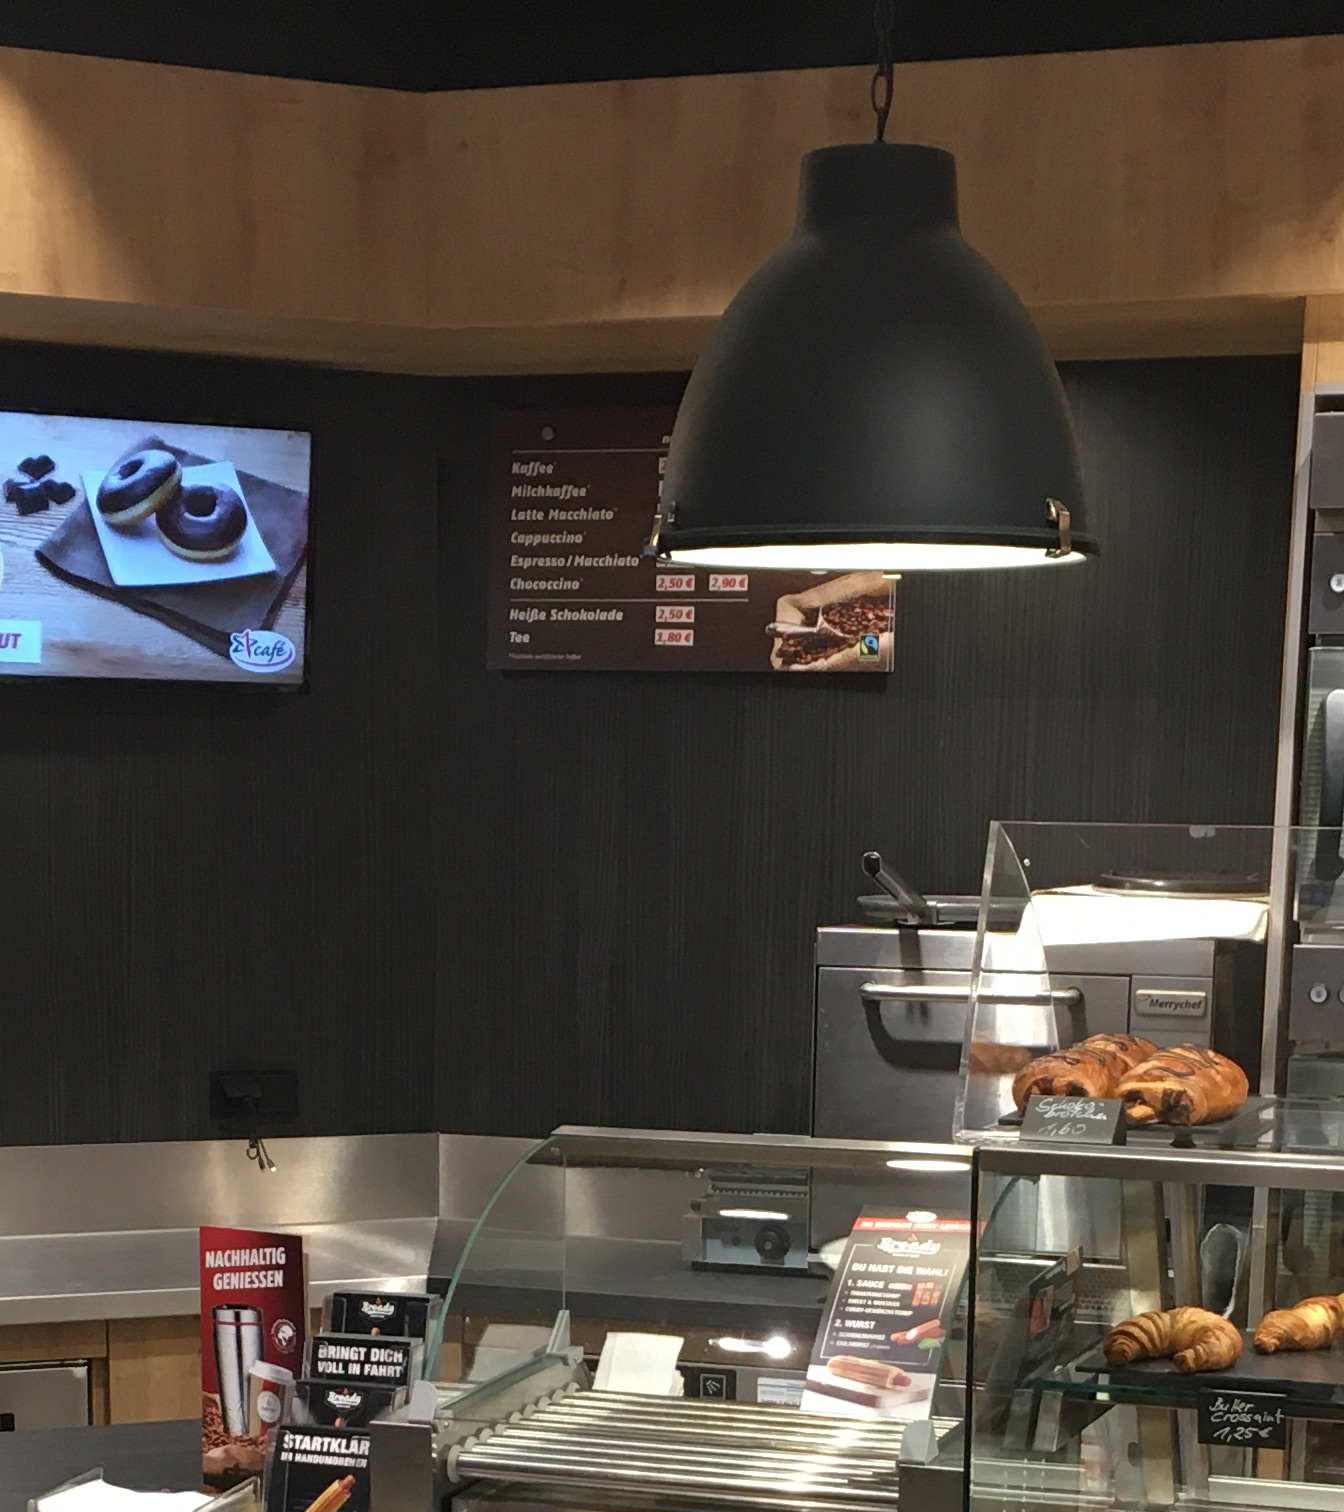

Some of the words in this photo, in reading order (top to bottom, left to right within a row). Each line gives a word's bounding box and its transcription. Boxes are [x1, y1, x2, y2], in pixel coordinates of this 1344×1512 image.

[511, 461, 554, 476] Kaffee
[511, 484, 587, 500] Milchkaffee
[511, 508, 544, 521] Latte
[548, 507, 614, 521] Macchiato
[510, 530, 583, 547] Cappuccino
[510, 577, 580, 591] Chococcino
[657, 578, 683, 591] 2,50
[710, 577, 737, 591] 2,90
[509, 608, 546, 623] Heiße
[550, 608, 624, 622] Schokolade
[657, 608, 683, 622] 2,50
[509, 631, 530, 643] Tee
[656, 632, 682, 645] 1,80
[254, 637, 288, 661] café
[1148, 998, 1202, 1011] Merrychef
[205, 1247, 286, 1269] NACHHALTIG
[852, 1262, 866, 1272] DU
[868, 1264, 895, 1274] HAST
[896, 1265, 914, 1275] DIE
[915, 1266, 949, 1277] WAHL!
[213, 1270, 284, 1291] GENIESSEN
[856, 1279, 885, 1289] SAUCE
[844, 1319, 876, 1329] WURST
[317, 1344, 367, 1361] BRINGT
[370, 1346, 403, 1363] DICH
[317, 1361, 345, 1375] VOLL
[348, 1362, 360, 1375] IN
[364, 1363, 402, 1378] FAHRT
[283, 1433, 371, 1456] STARTKLAR
